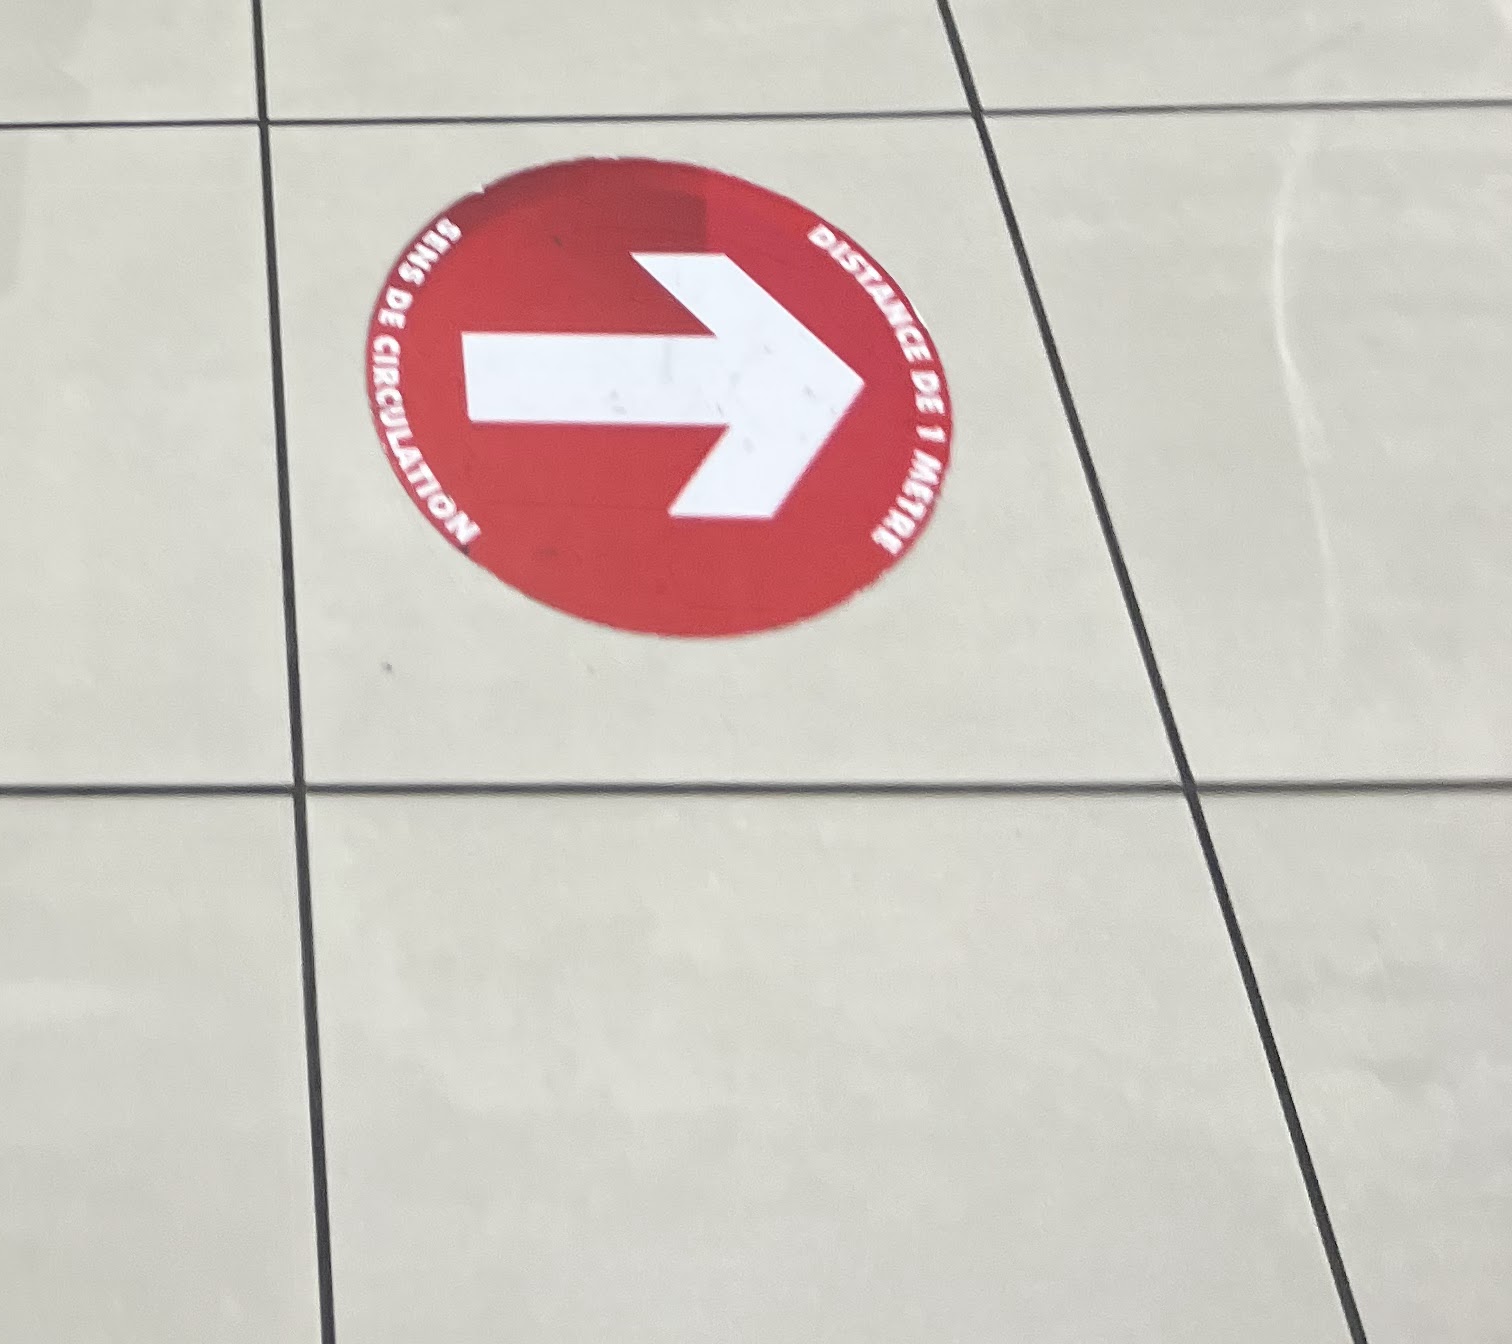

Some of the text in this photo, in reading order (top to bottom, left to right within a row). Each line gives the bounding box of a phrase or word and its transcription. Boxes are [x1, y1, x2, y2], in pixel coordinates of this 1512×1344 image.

[807, 223, 934, 363] DISTANCE
[372, 216, 482, 545] SENS DE CIRCULATION
[910, 368, 946, 414] DE
[915, 424, 947, 443] 1
